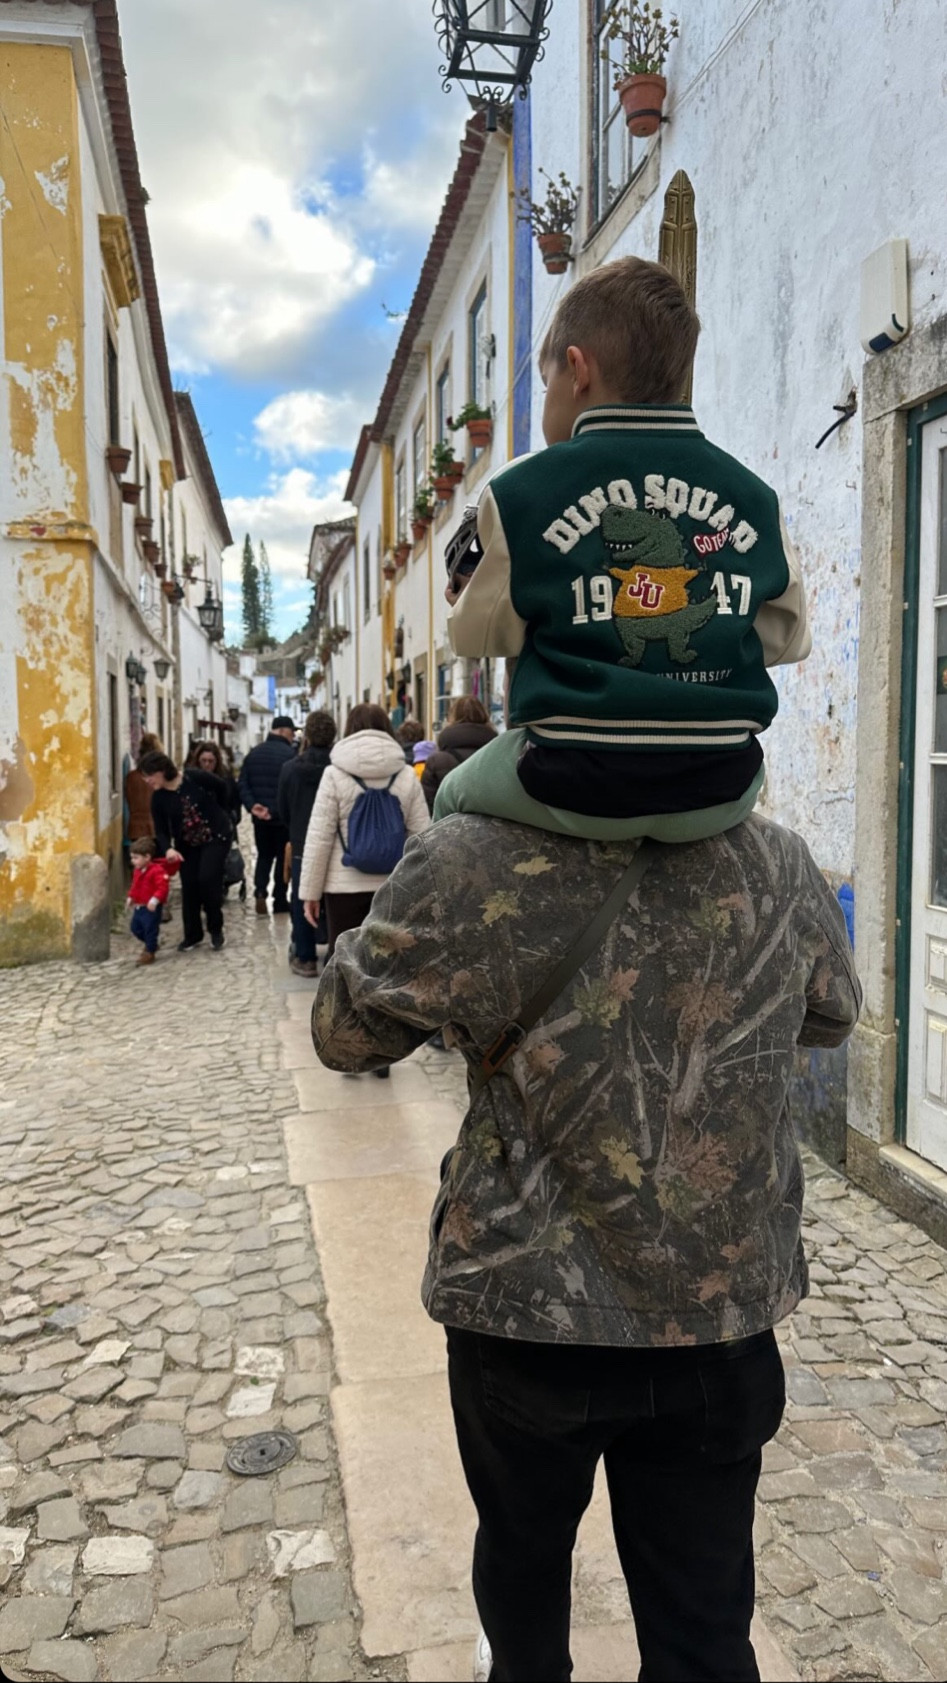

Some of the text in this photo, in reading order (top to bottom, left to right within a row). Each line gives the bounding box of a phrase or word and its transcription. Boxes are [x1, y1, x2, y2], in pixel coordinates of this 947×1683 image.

[542, 474, 758, 554] DINO SQUAD
[693, 535, 712, 553] GO
[571, 575, 613, 625] 19
[627, 572, 663, 609] JU
